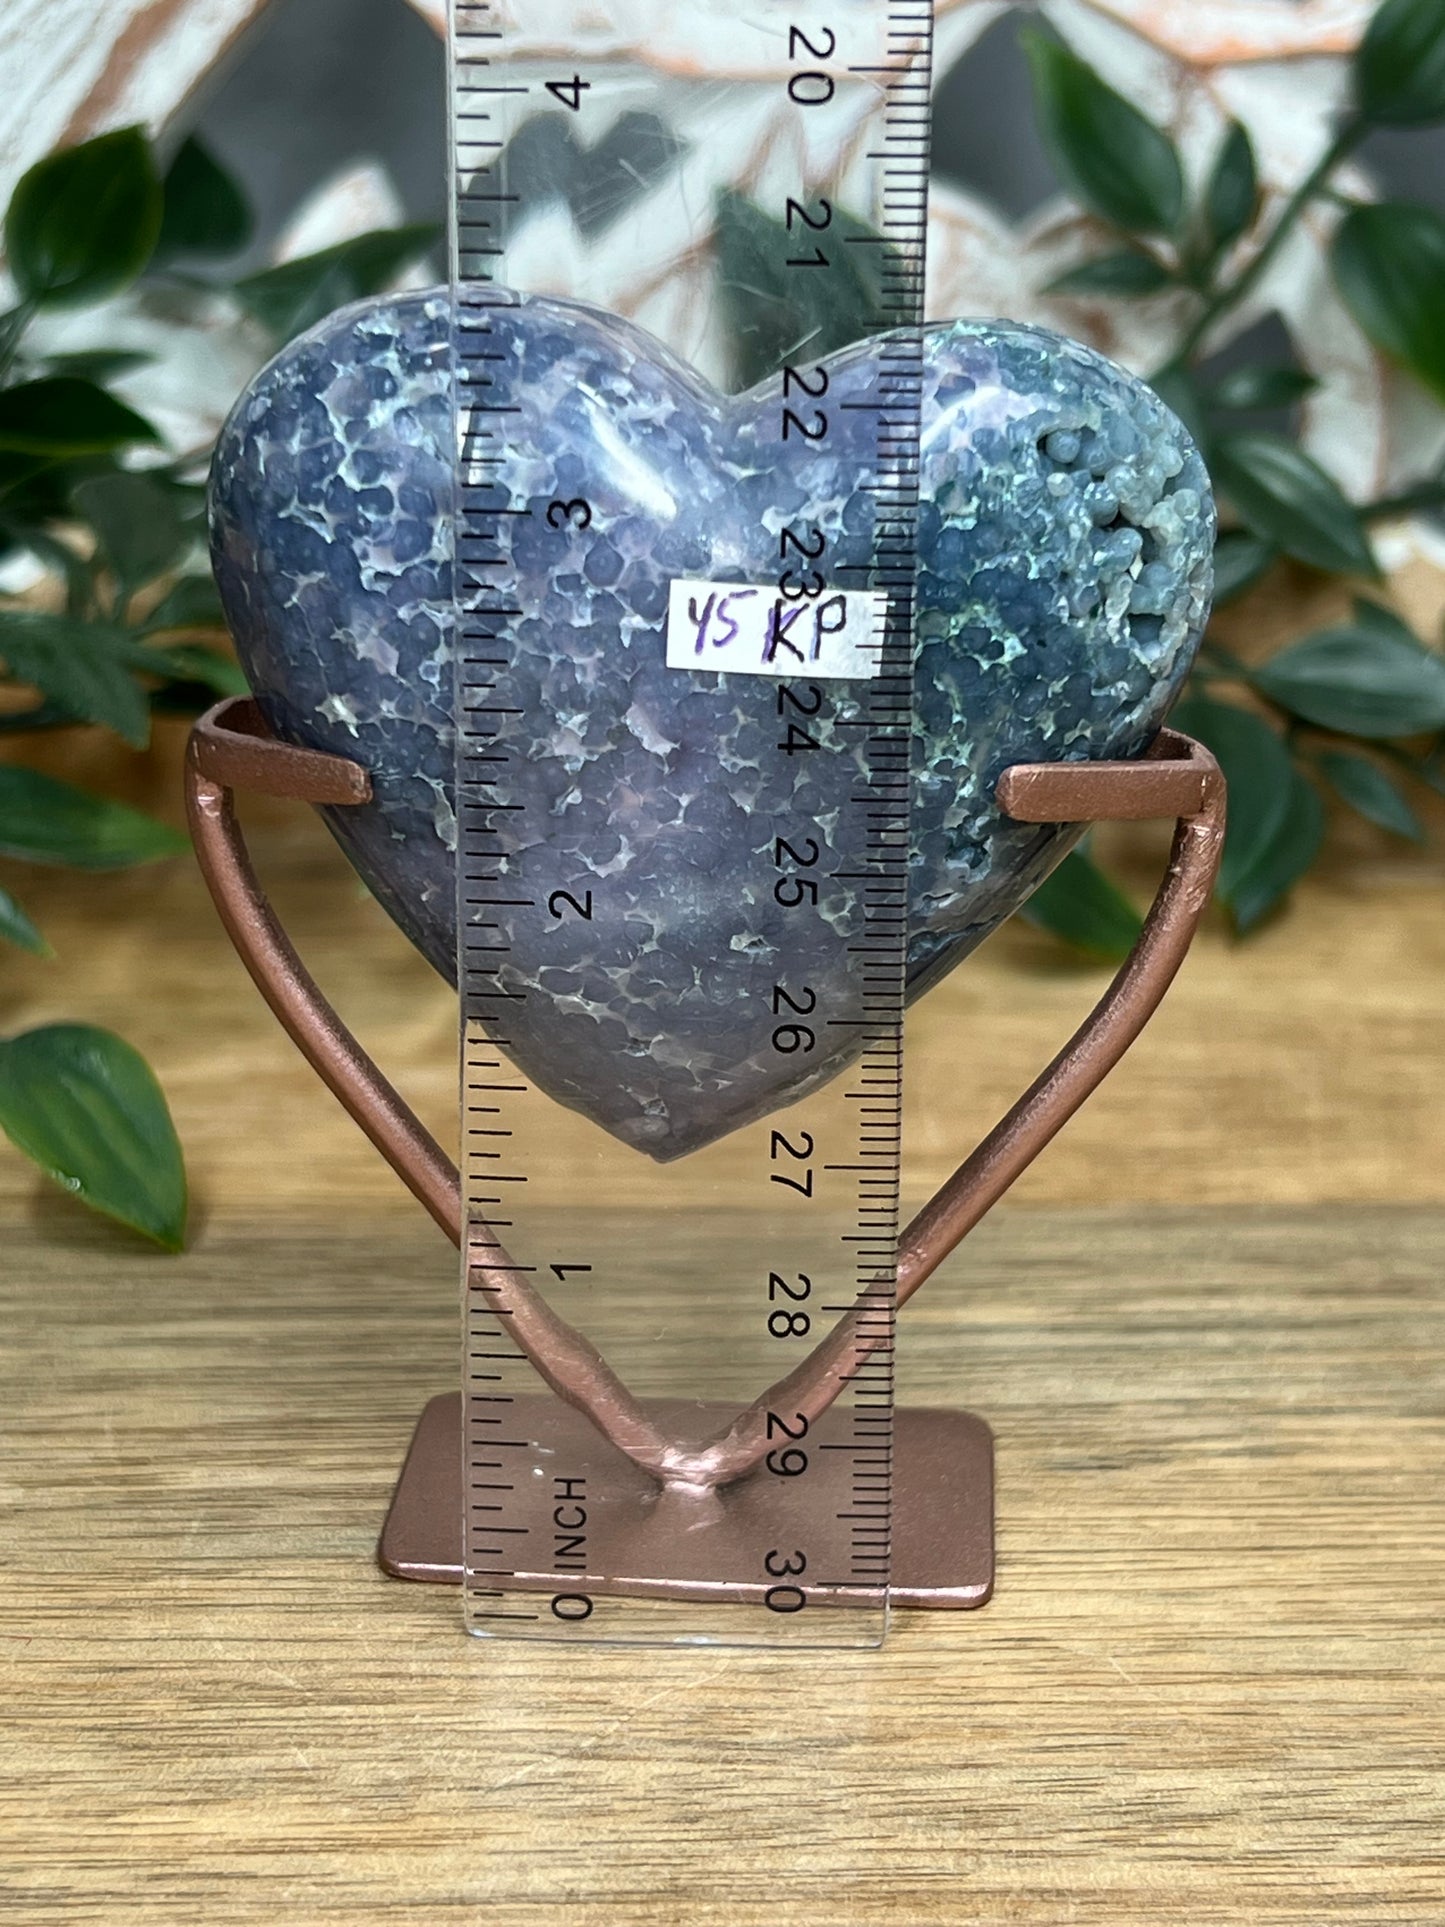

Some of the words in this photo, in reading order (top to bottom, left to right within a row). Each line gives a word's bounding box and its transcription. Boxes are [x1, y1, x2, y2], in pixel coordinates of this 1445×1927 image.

[546, 74, 591, 110] 4
[789, 25, 835, 106] 20
[786, 198, 831, 268] 21
[782, 366, 828, 442] 22
[547, 498, 592, 530] 3
[780, 527, 825, 601] 23
[777, 684, 822, 756] 24
[548, 889, 592, 920] 2
[774, 836, 819, 908] 25
[772, 986, 817, 1056] 26
[770, 1130, 813, 1199] 27
[549, 1263, 592, 1281] 1
[767, 1272, 810, 1339] 28
[765, 1412, 808, 1478] 29
[553, 1477, 587, 1570] INCH
[551, 1593, 594, 1621] 0
[764, 1549, 807, 1614] 30
